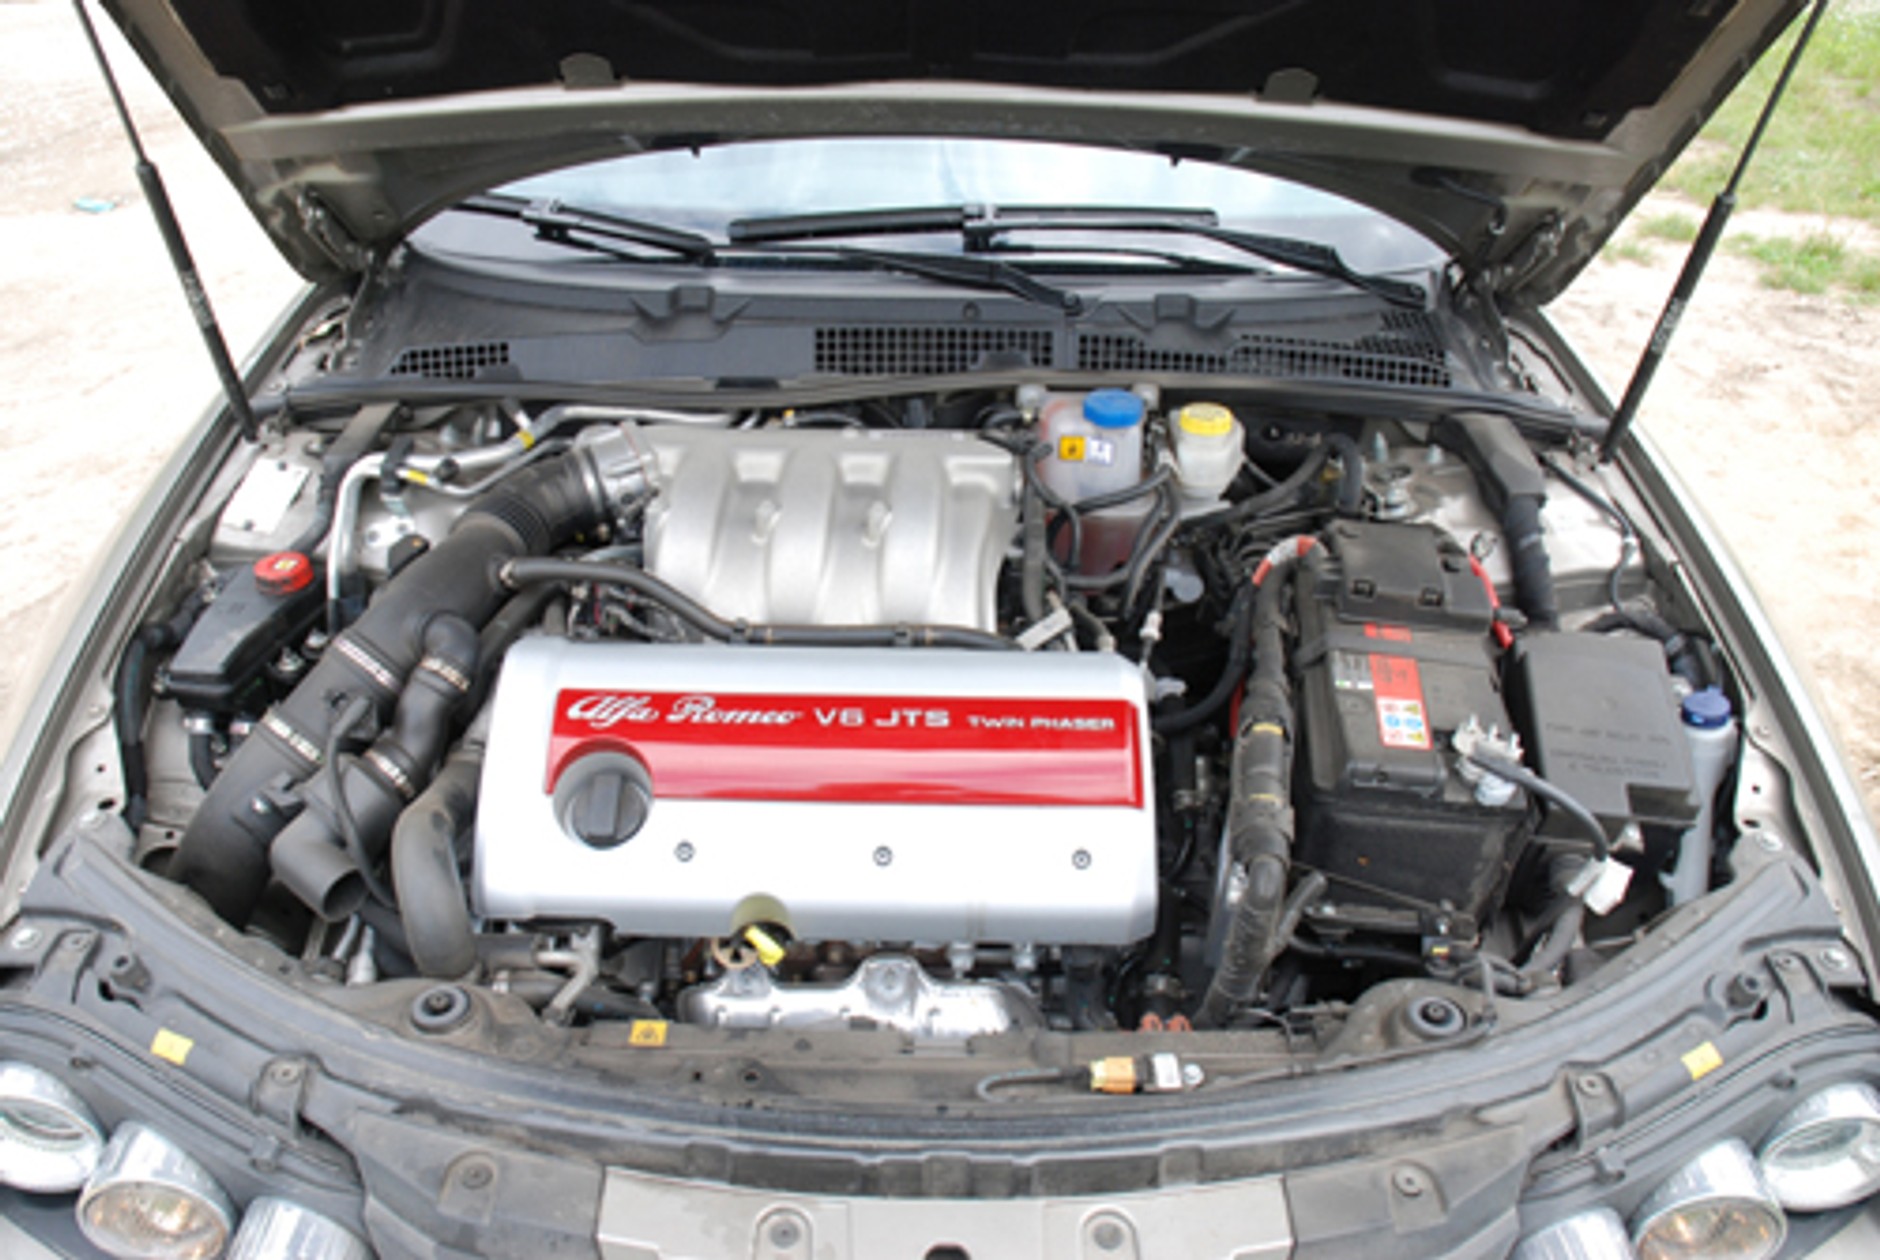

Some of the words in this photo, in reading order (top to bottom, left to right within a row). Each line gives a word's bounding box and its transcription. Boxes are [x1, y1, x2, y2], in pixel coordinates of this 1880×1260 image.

[566, 695, 660, 729] Alfa
[665, 695, 804, 724] Romeo
[813, 707, 865, 727] V6
[874, 708, 950, 728] JTS
[1030, 716, 1116, 731] PHASER
